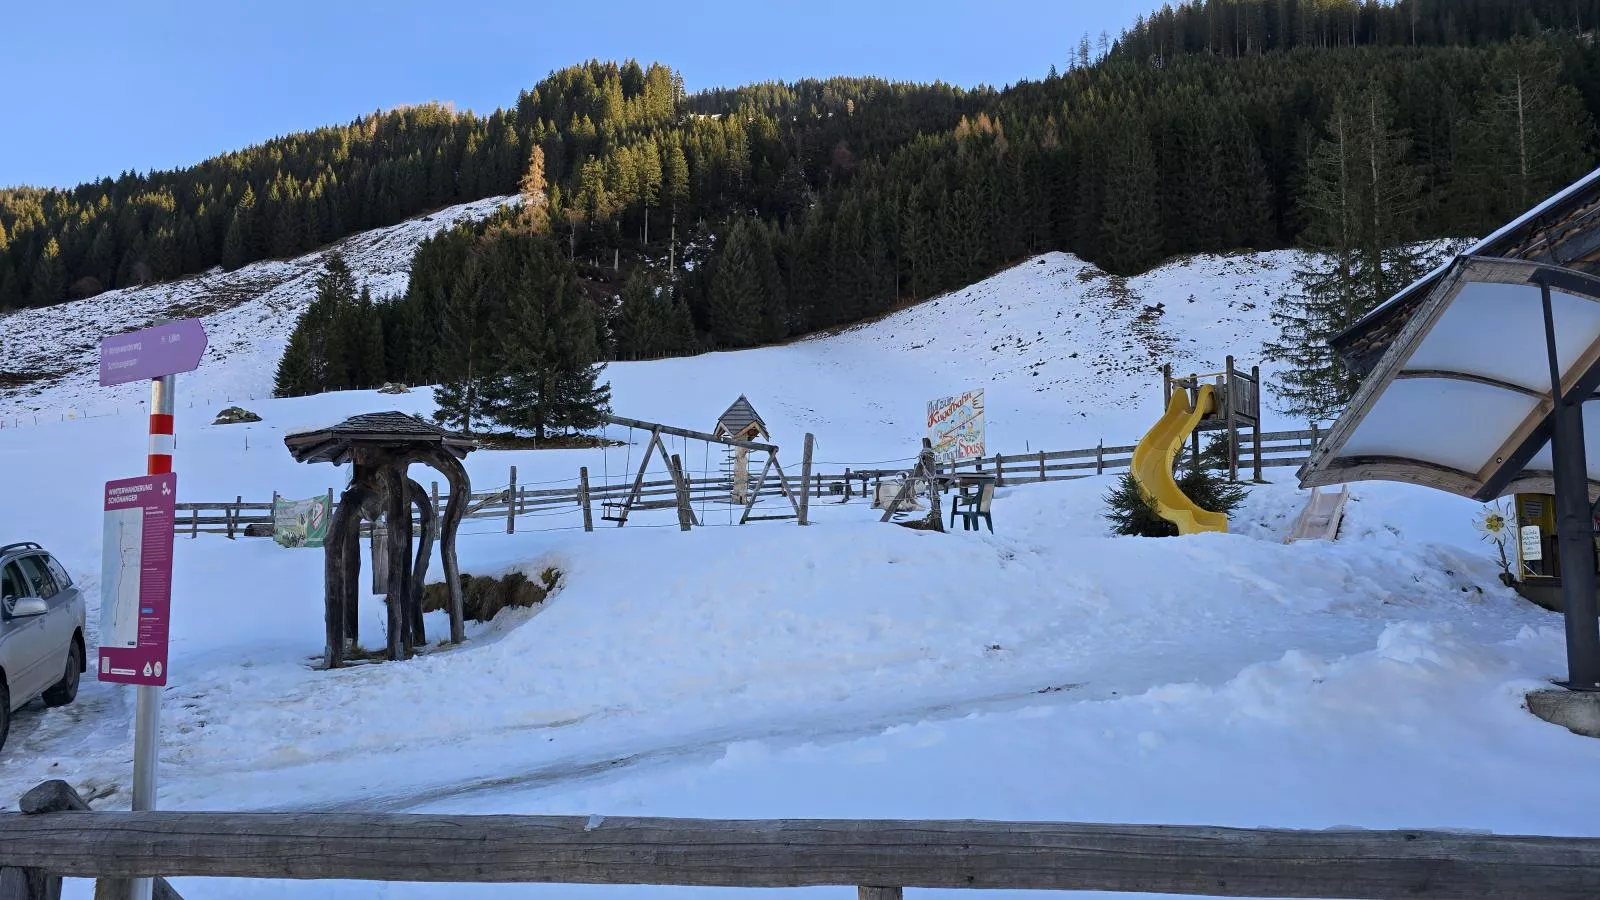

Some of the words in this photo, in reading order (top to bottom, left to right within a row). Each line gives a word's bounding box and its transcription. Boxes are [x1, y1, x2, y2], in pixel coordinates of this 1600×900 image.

[959, 439, 984, 457] Spass
[109, 484, 153, 495] WINTERWANDERUNG
[108, 495, 138, 504] SCHÖNANGER
